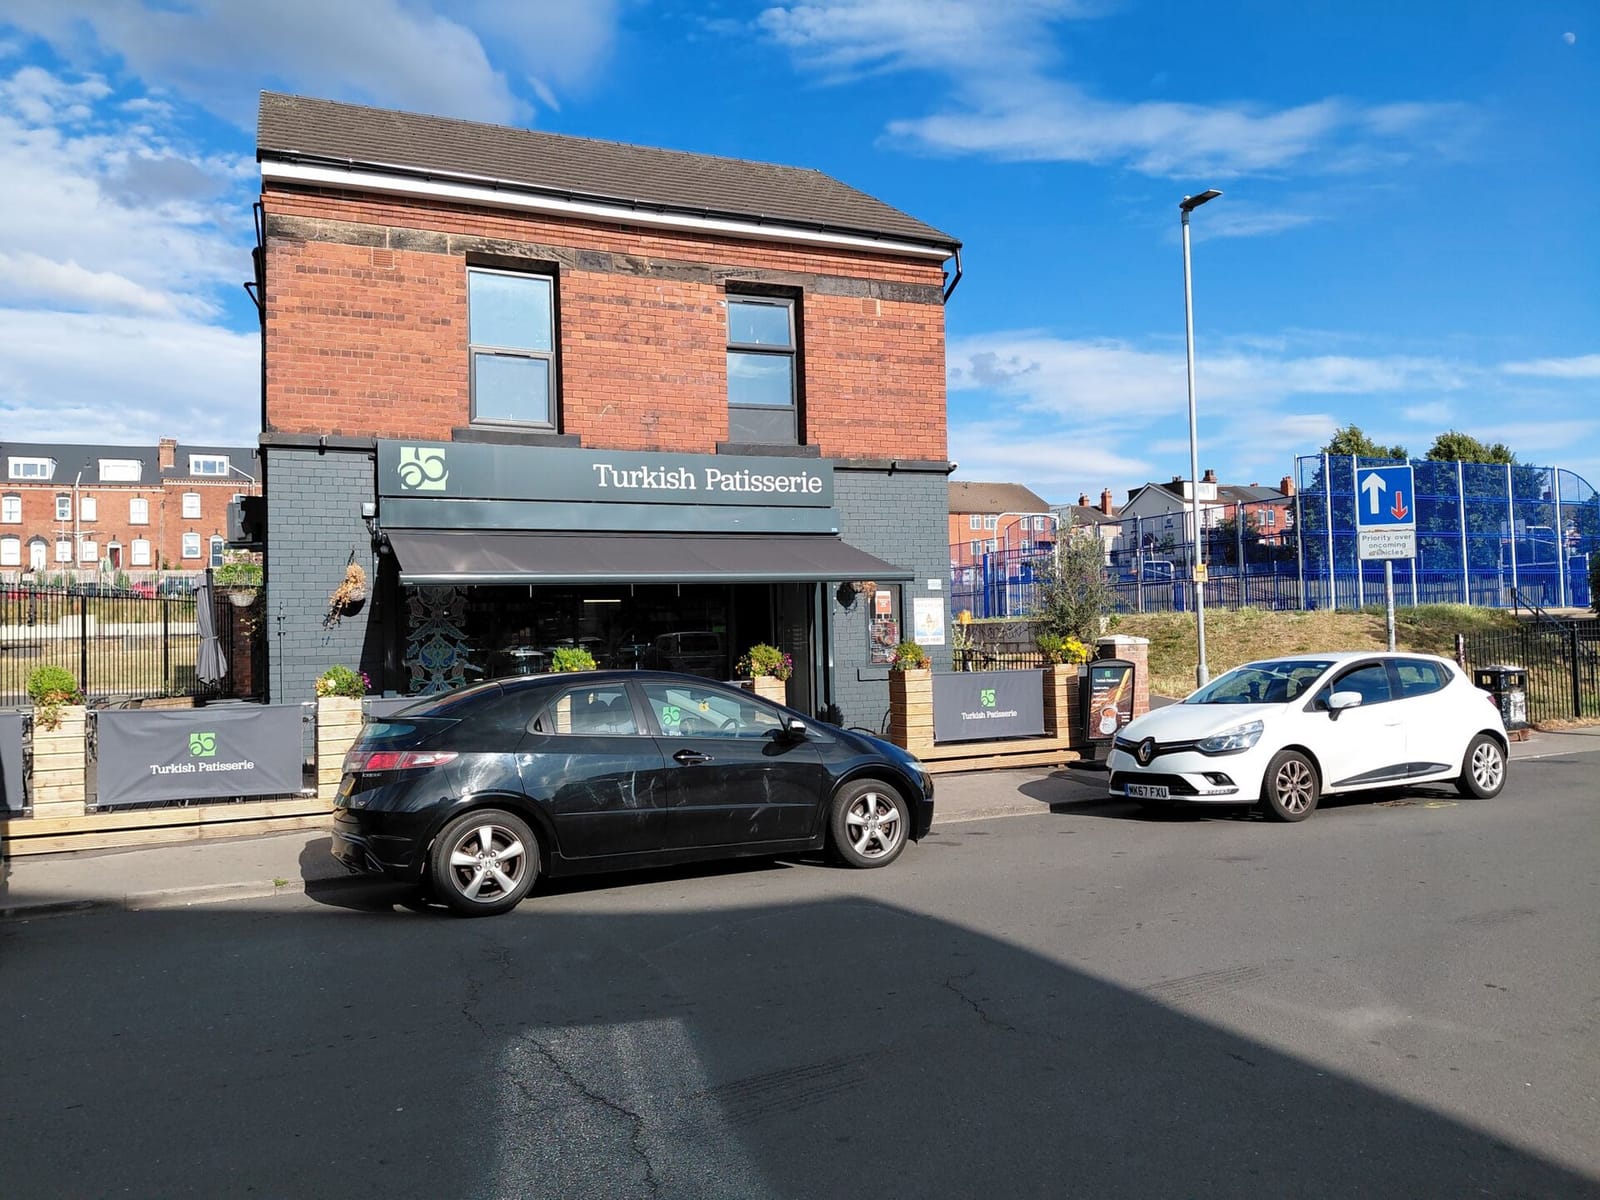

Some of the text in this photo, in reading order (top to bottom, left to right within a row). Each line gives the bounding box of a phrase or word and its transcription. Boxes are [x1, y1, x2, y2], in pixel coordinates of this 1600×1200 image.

[593, 464, 823, 493] Turkish Patisserie
[961, 709, 1018, 720] Turkish Patisserie
[150, 760, 255, 775] Turkish Patisserie
[1150, 787, 1167, 798] FXU
